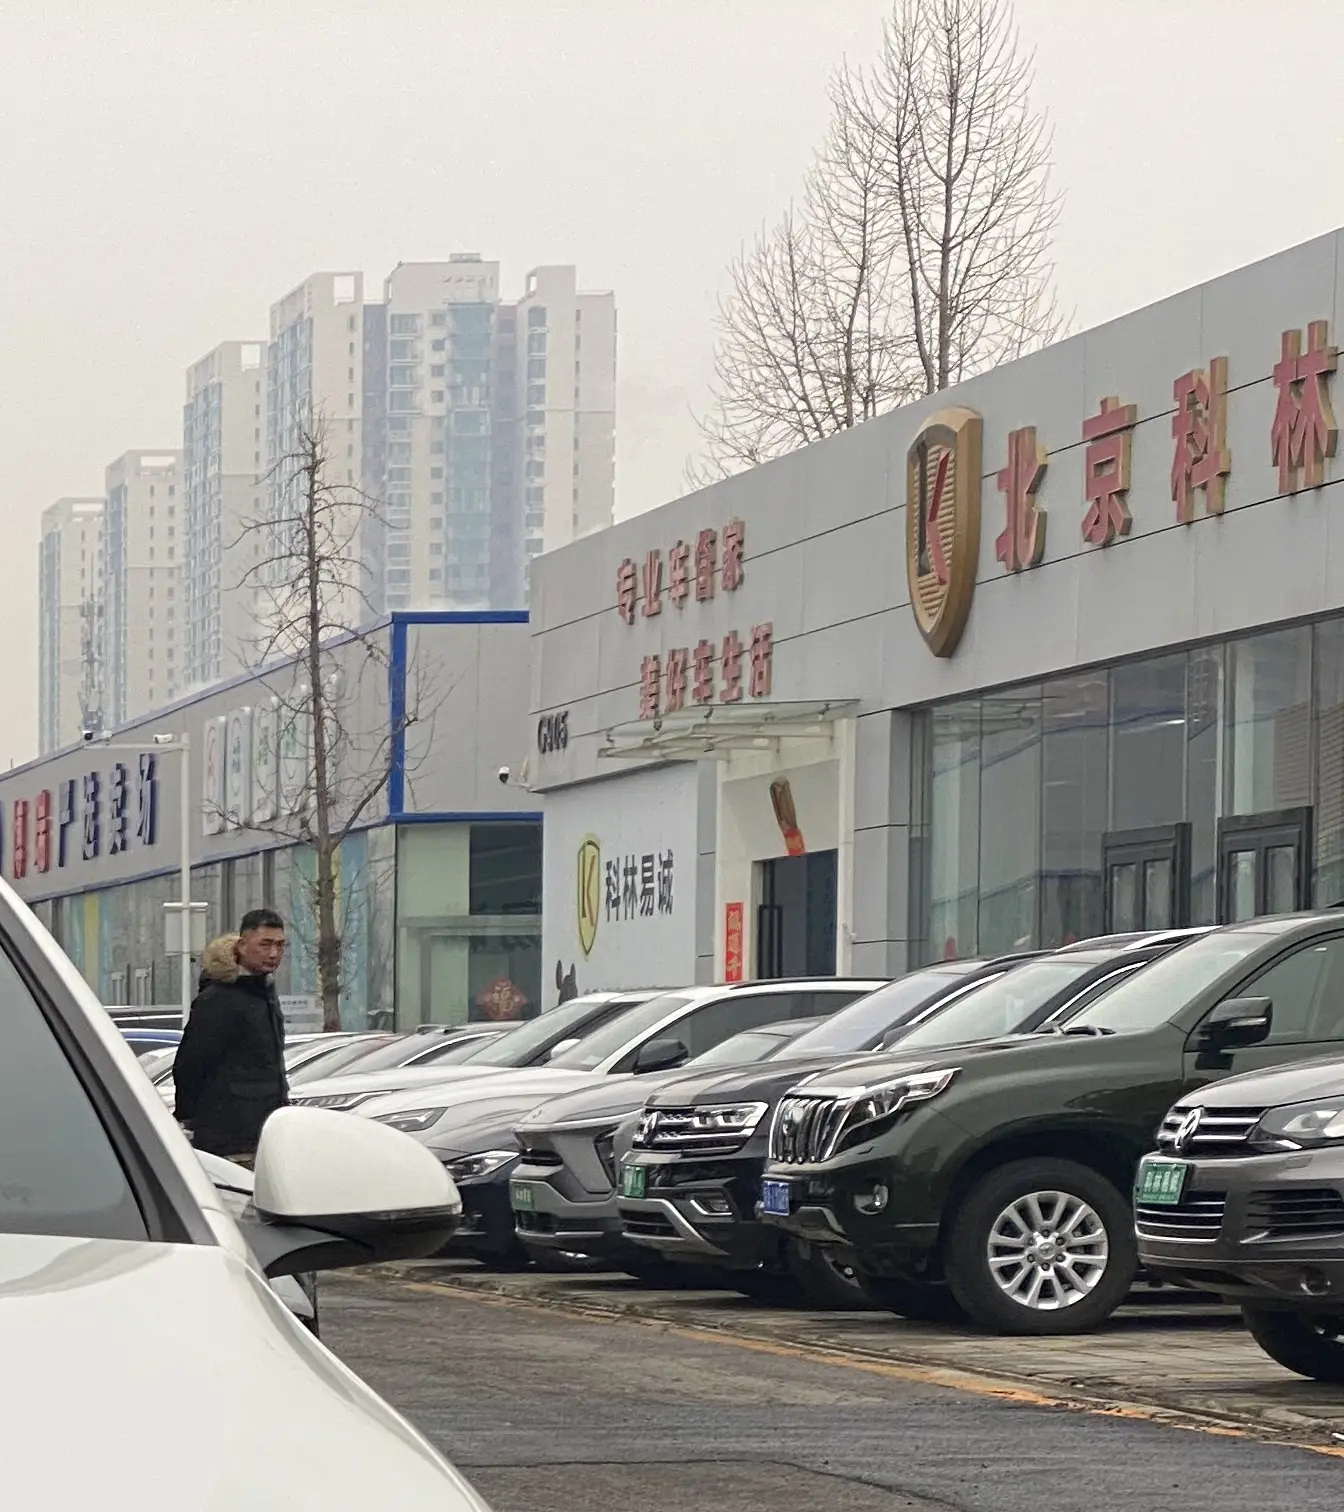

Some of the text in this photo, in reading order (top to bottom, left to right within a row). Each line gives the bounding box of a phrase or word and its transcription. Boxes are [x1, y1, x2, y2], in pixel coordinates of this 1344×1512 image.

[996, 319, 1339, 573] 北京科林
[605, 848, 674, 923] 科林易诚
